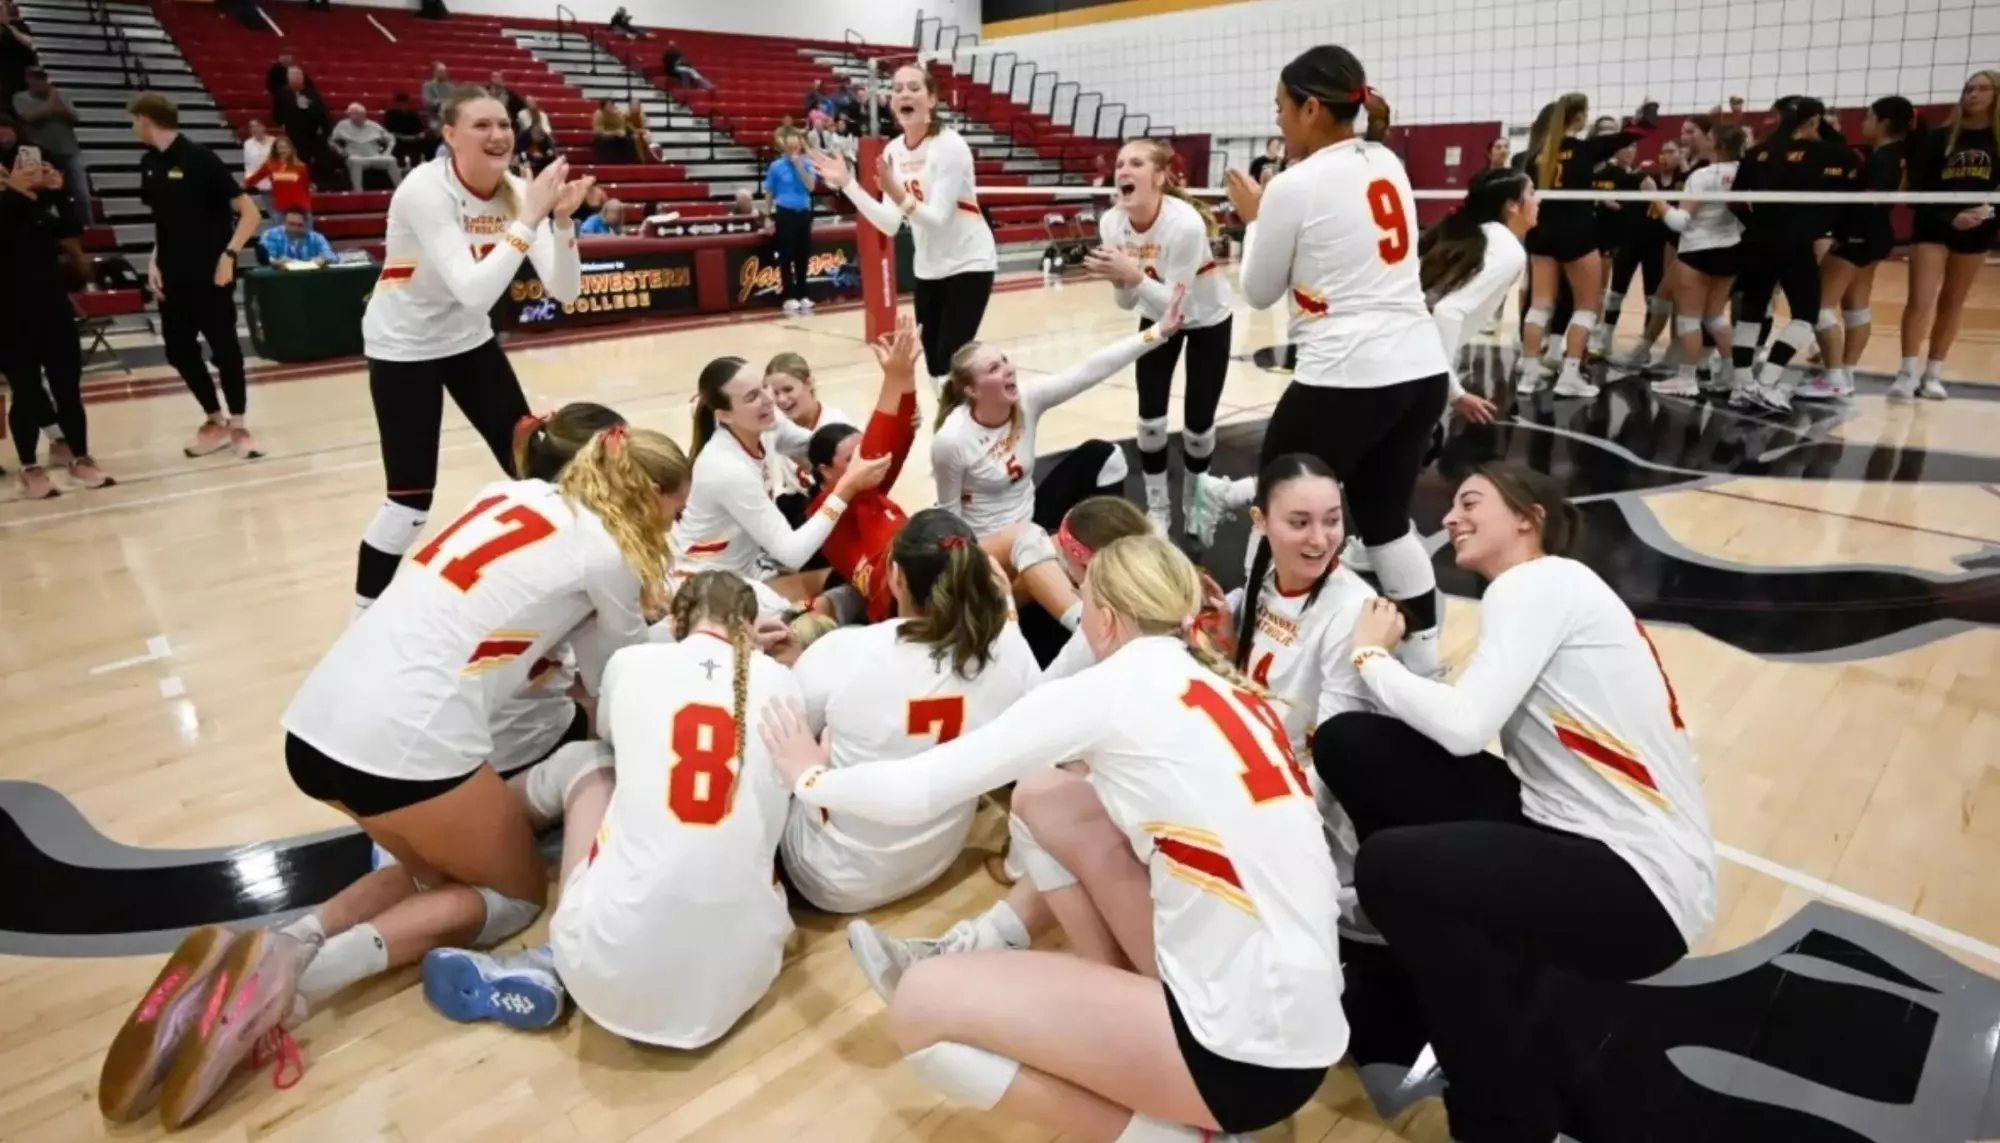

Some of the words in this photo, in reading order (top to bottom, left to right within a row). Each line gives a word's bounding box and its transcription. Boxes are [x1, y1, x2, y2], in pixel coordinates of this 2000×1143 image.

[1366, 178, 1410, 265] 9
[509, 266, 692, 302] SOHWESTERN
[411, 492, 558, 593] 17
[906, 693, 967, 745] 7
[667, 701, 737, 826] 8
